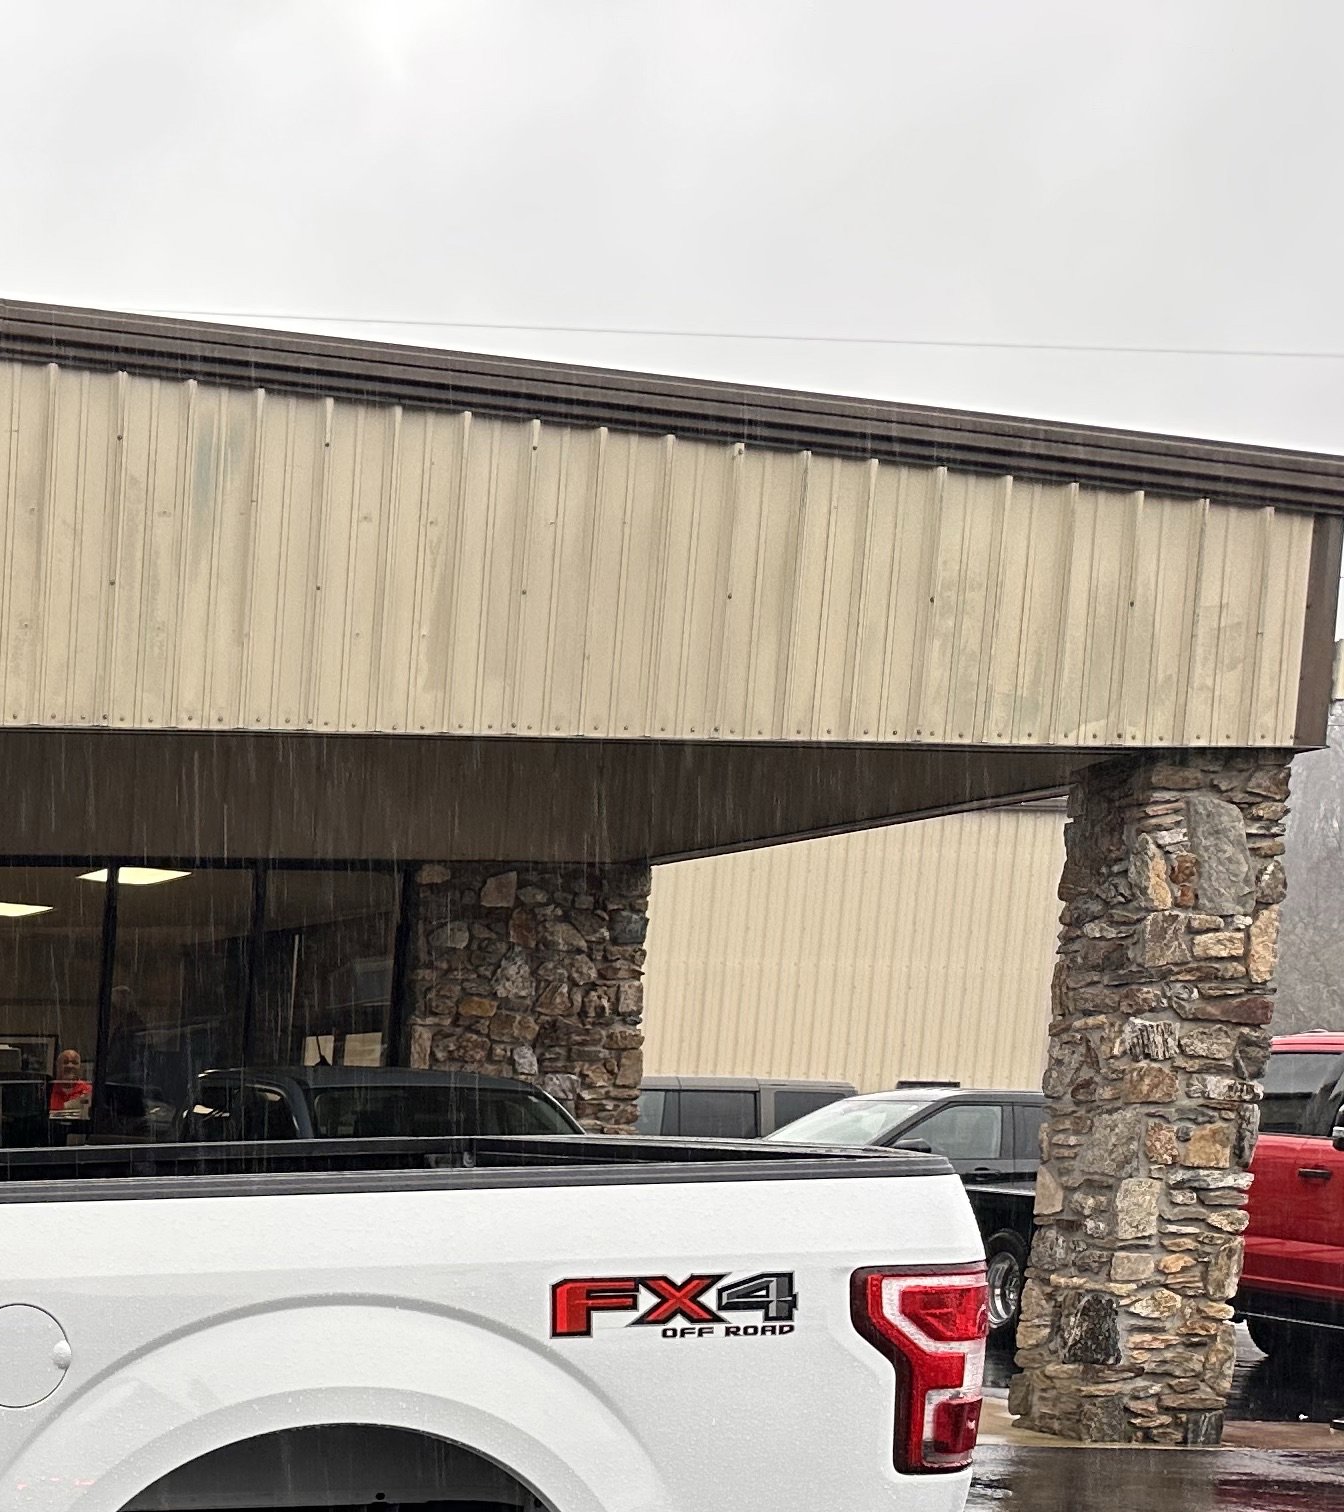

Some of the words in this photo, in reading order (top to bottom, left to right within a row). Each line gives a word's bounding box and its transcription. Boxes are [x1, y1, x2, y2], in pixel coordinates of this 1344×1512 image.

[550, 1270, 798, 1339] FX4
[662, 1326, 714, 1338] OFF
[725, 1325, 795, 1337] ROAD
